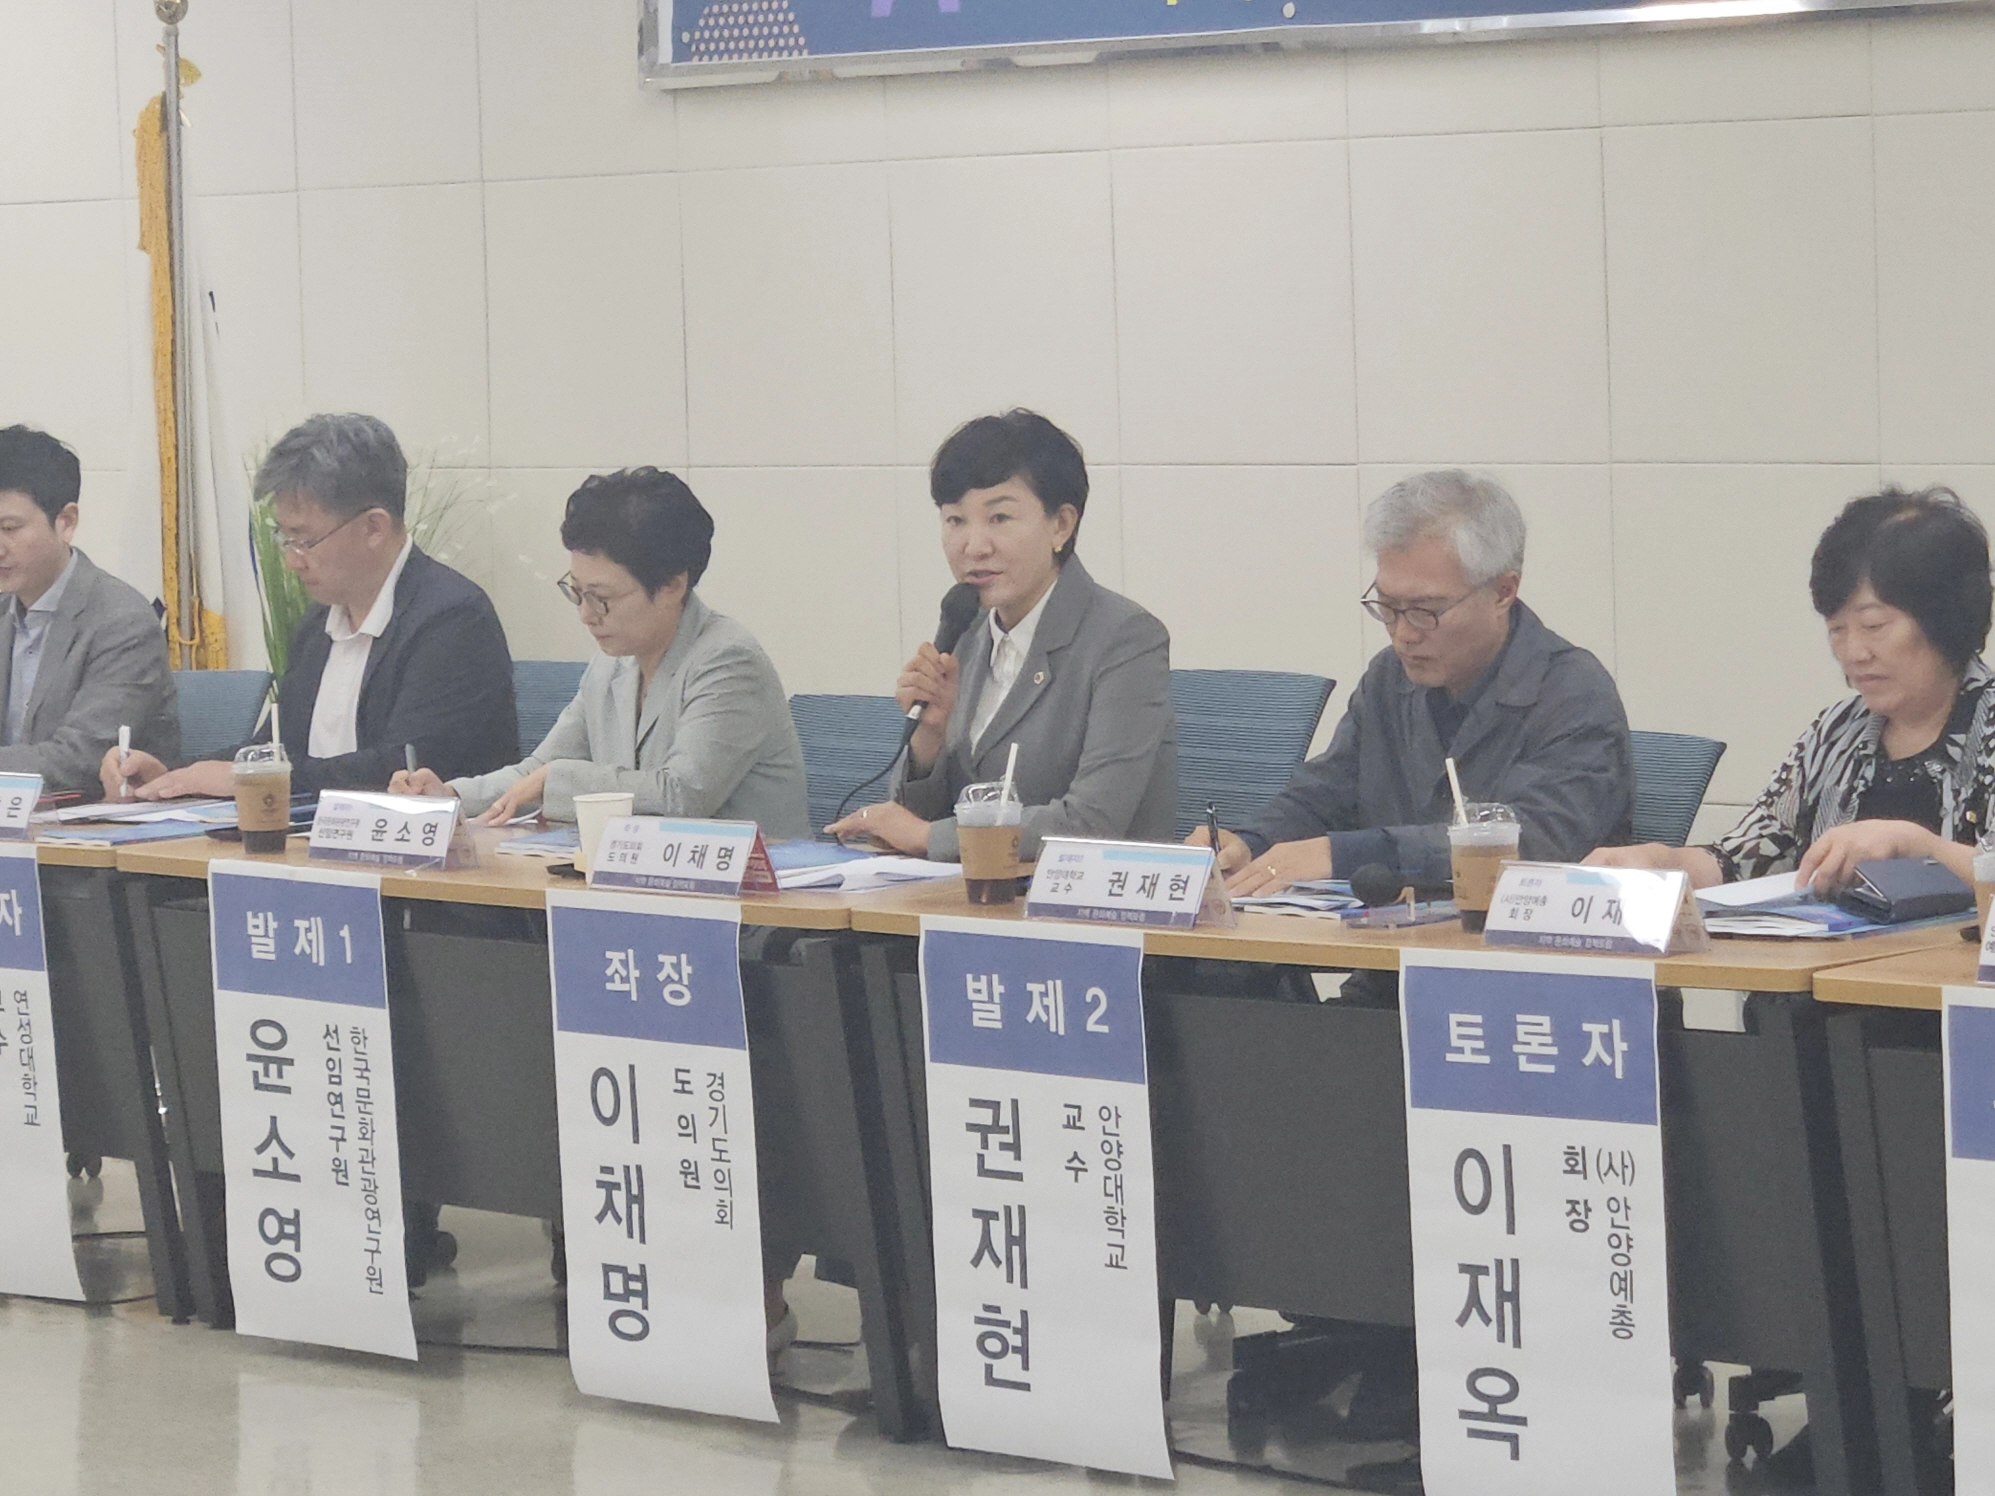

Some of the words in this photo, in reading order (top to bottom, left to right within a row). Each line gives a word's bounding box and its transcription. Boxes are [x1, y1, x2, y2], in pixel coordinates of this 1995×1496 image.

[0, 795, 22, 819] 은
[371, 818, 439, 847] 윤소영
[606, 852, 639, 865] 도의원
[662, 842, 735, 871] 이채명
[1047, 869, 1085, 881] 안양대학교
[1050, 883, 1073, 894] 교수
[1107, 870, 1190, 902] 권재현
[1508, 907, 1534, 921] 회장
[1571, 895, 1623, 926] 이재
[604, 949, 693, 1007] 좌장
[13, 989, 41, 1127] 연성대학교
[1445, 1013, 1628, 1080] 토론자
[322, 1023, 349, 1188] 선임연구원
[672, 1068, 702, 1191] 도의원
[1061, 1103, 1089, 1184] 교수
[246, 1018, 302, 1283] 윤소영
[349, 1027, 384, 1295] 한국문화관광연구원
[705, 1071, 735, 1230] 경기도의회
[1098, 1105, 1129, 1270] 안양대학교
[1562, 1145, 1592, 1234] 회장
[590, 1063, 651, 1342] 이채명
[964, 1096, 1032, 1392] 권재현
[1453, 1143, 1529, 1461] 이재옥
